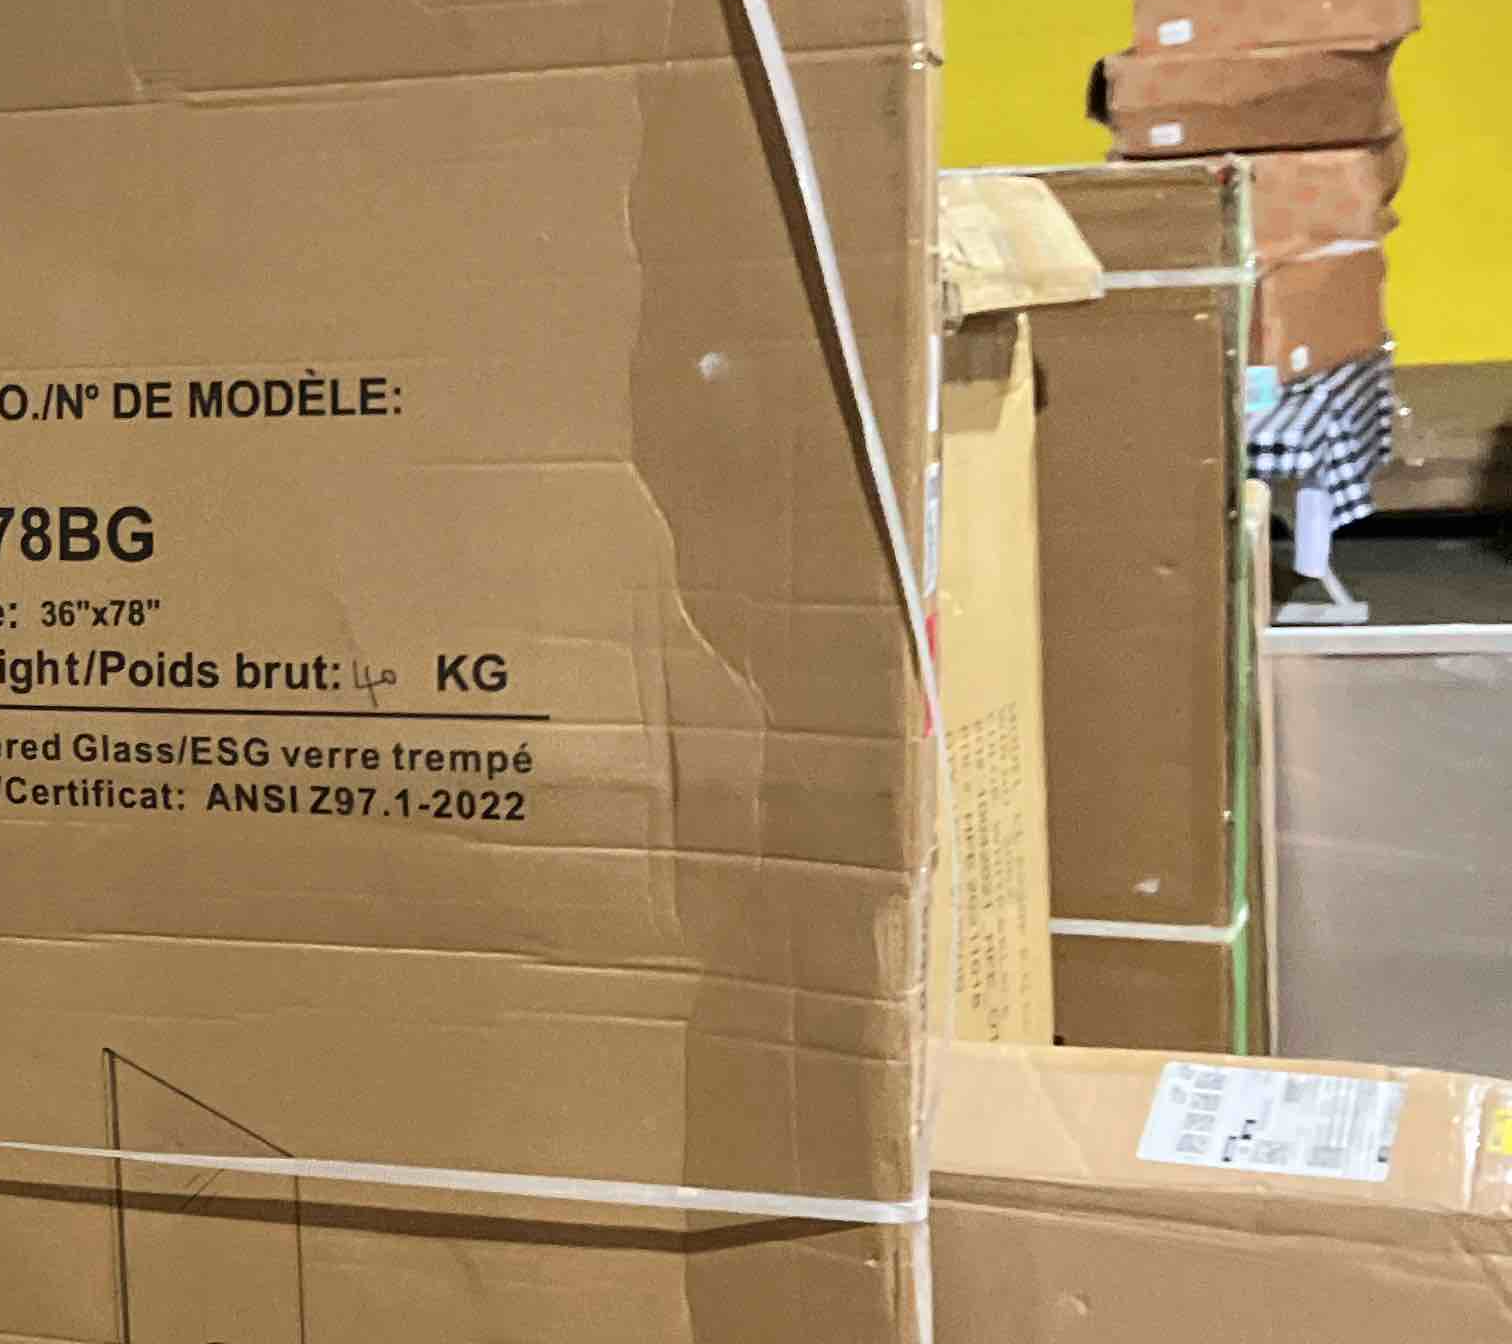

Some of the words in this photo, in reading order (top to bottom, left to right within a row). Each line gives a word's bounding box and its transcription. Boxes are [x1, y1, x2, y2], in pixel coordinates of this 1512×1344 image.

[113, 381, 173, 419] DE
[189, 368, 402, 418] MODÈLE:
[41, 599, 161, 628] 36"x78"
[236, 652, 340, 690] brut:
[437, 654, 509, 693] KG
[73, 732, 270, 767] Glass/ESG
[280, 744, 381, 770] verre
[391, 742, 534, 781] trempé
[206, 782, 297, 815] ANSI
[309, 785, 526, 821] Z97.1-2022
